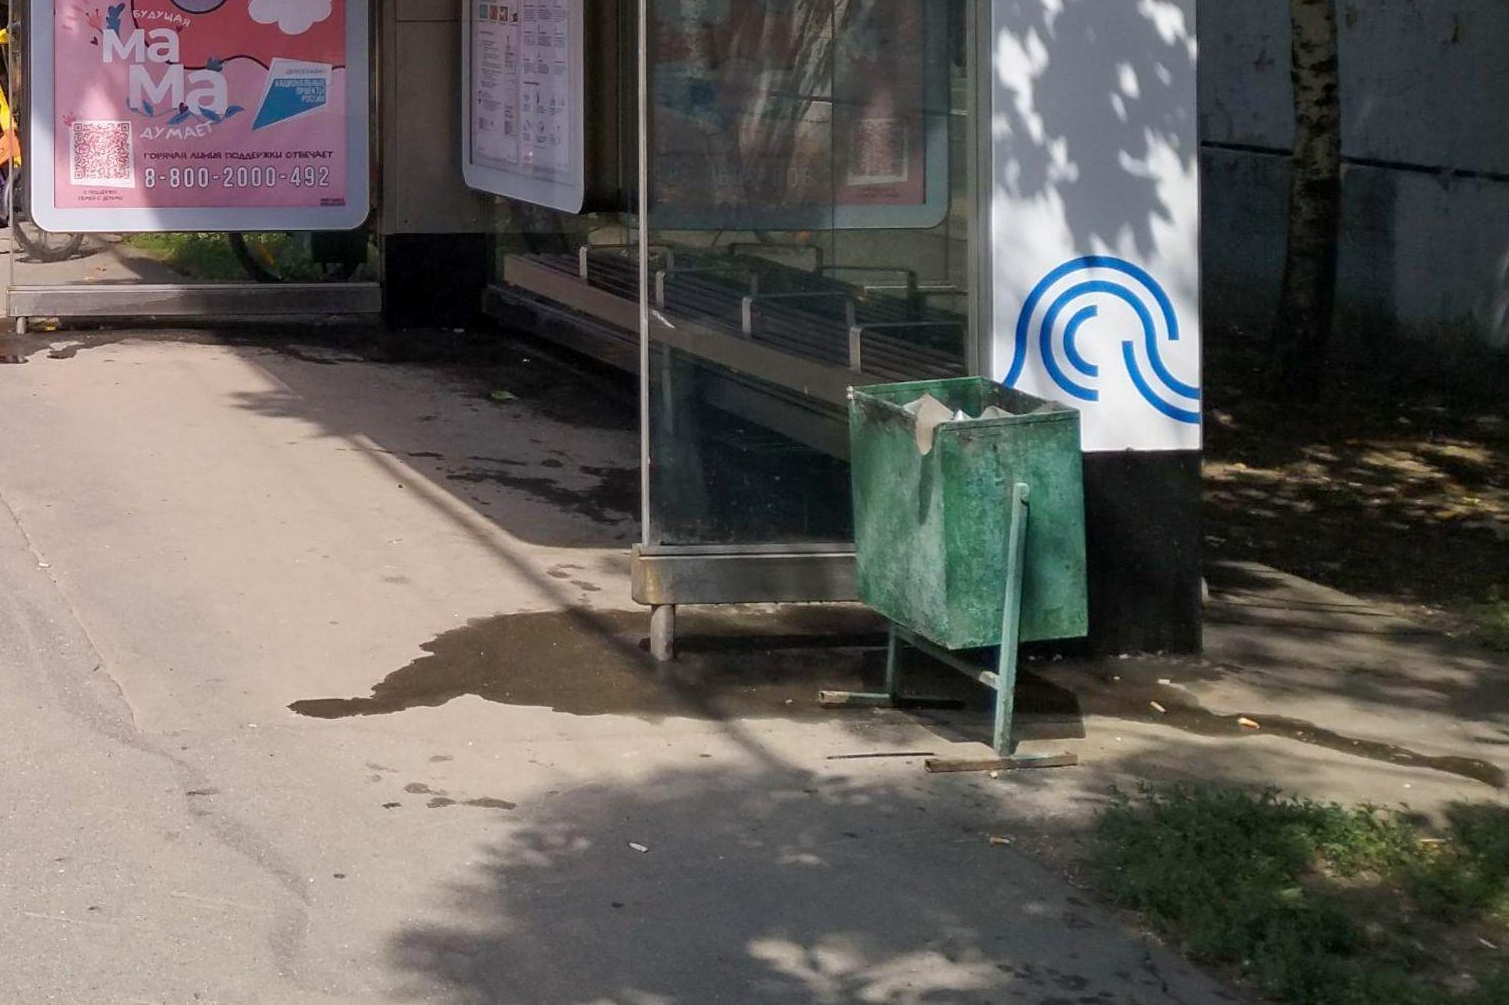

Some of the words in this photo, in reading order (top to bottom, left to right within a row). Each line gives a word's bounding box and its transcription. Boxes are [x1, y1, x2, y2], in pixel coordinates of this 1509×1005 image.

[132, 9, 191, 27] БУДУЩАЯ
[140, 120, 214, 140] ДУМАЕТ
[143, 151, 187, 160] ГОРЯЧАЯ
[190, 151, 222, 159] ЛИНИЯ
[225, 151, 283, 160] ПОДДЕРЖКИ
[285, 150, 333, 159] ОТВЕЧАЕТ
[144, 166, 330, 188] 8-800-2000-492
